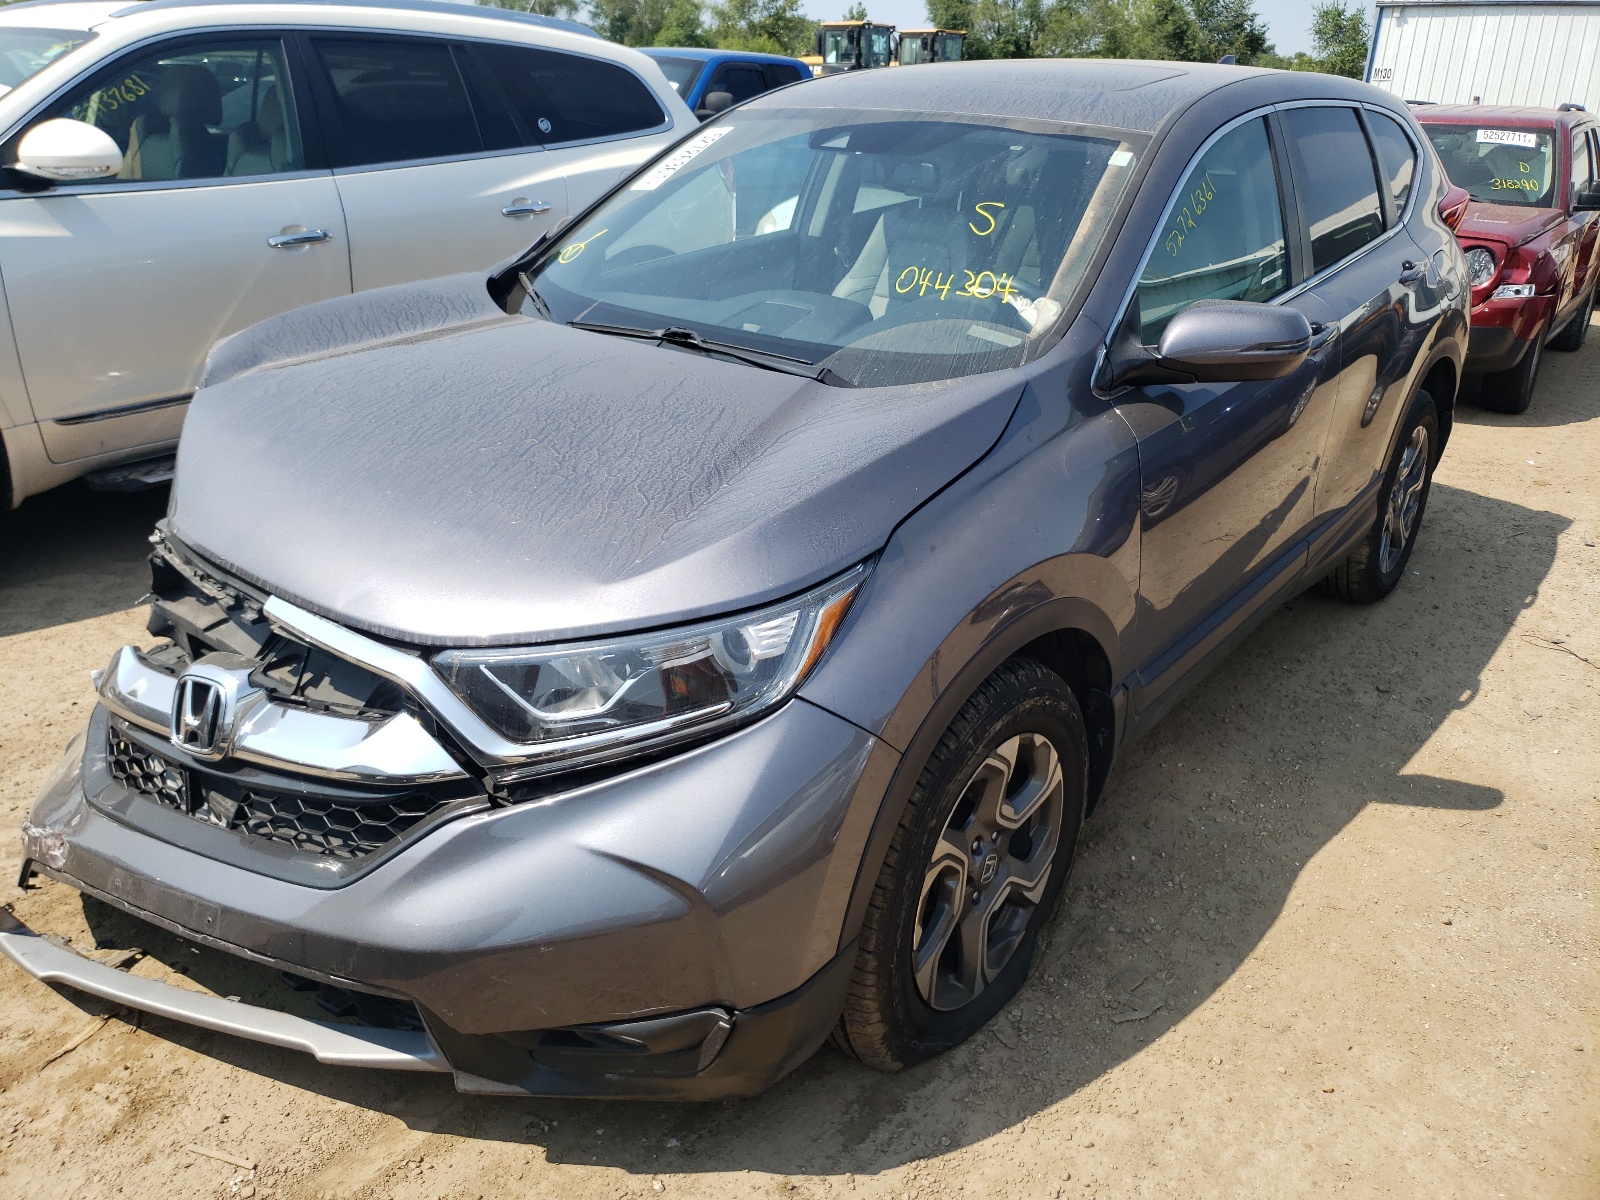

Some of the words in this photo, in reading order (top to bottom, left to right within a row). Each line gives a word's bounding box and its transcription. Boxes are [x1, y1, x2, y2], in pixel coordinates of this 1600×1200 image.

[1372, 67, 1392, 80] M130
[1491, 177, 1539, 192] 318290
[895, 266, 1019, 304] 044304
